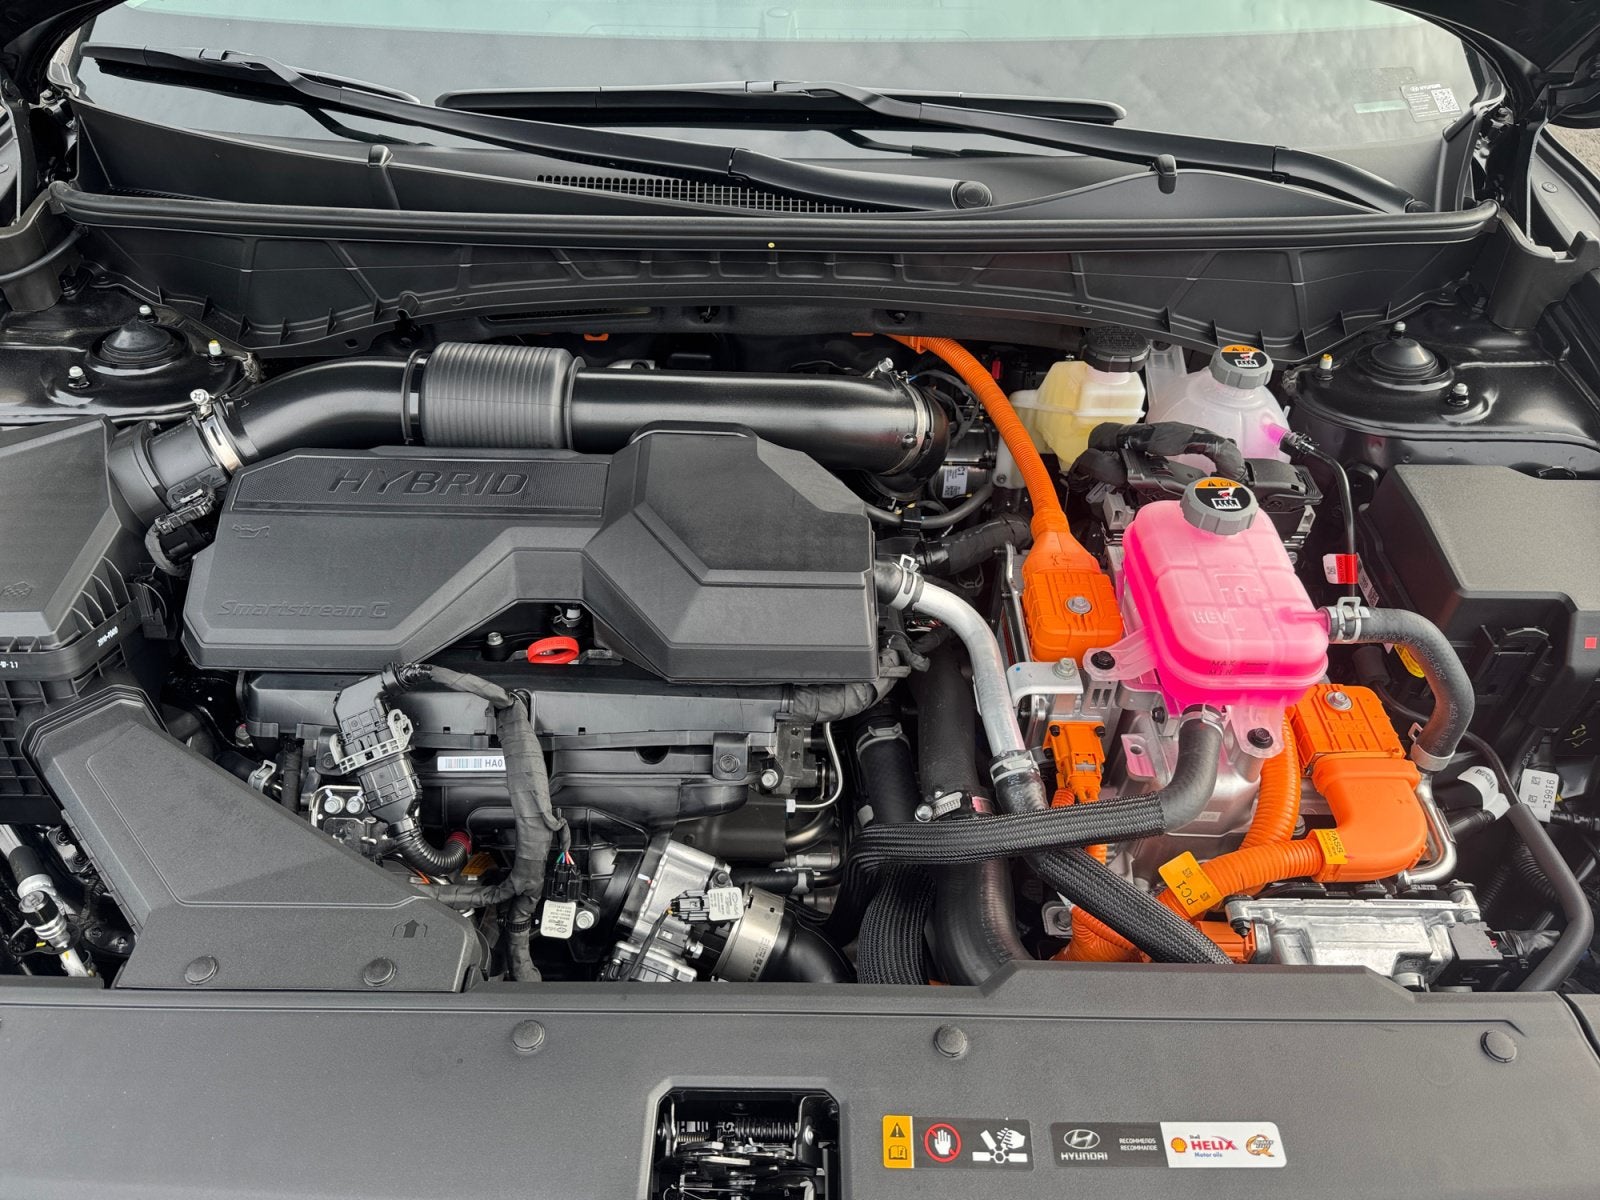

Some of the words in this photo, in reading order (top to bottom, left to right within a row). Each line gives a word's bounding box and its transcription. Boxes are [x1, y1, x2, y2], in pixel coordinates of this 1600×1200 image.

[328, 468, 529, 496] HYBRID
[216, 600, 367, 618] Smartstream
[369, 601, 392, 619] G
[1176, 880, 1200, 905] PC1
[1190, 1140, 1238, 1151] HELIX
[1060, 1152, 1109, 1160] HYUNDAI
